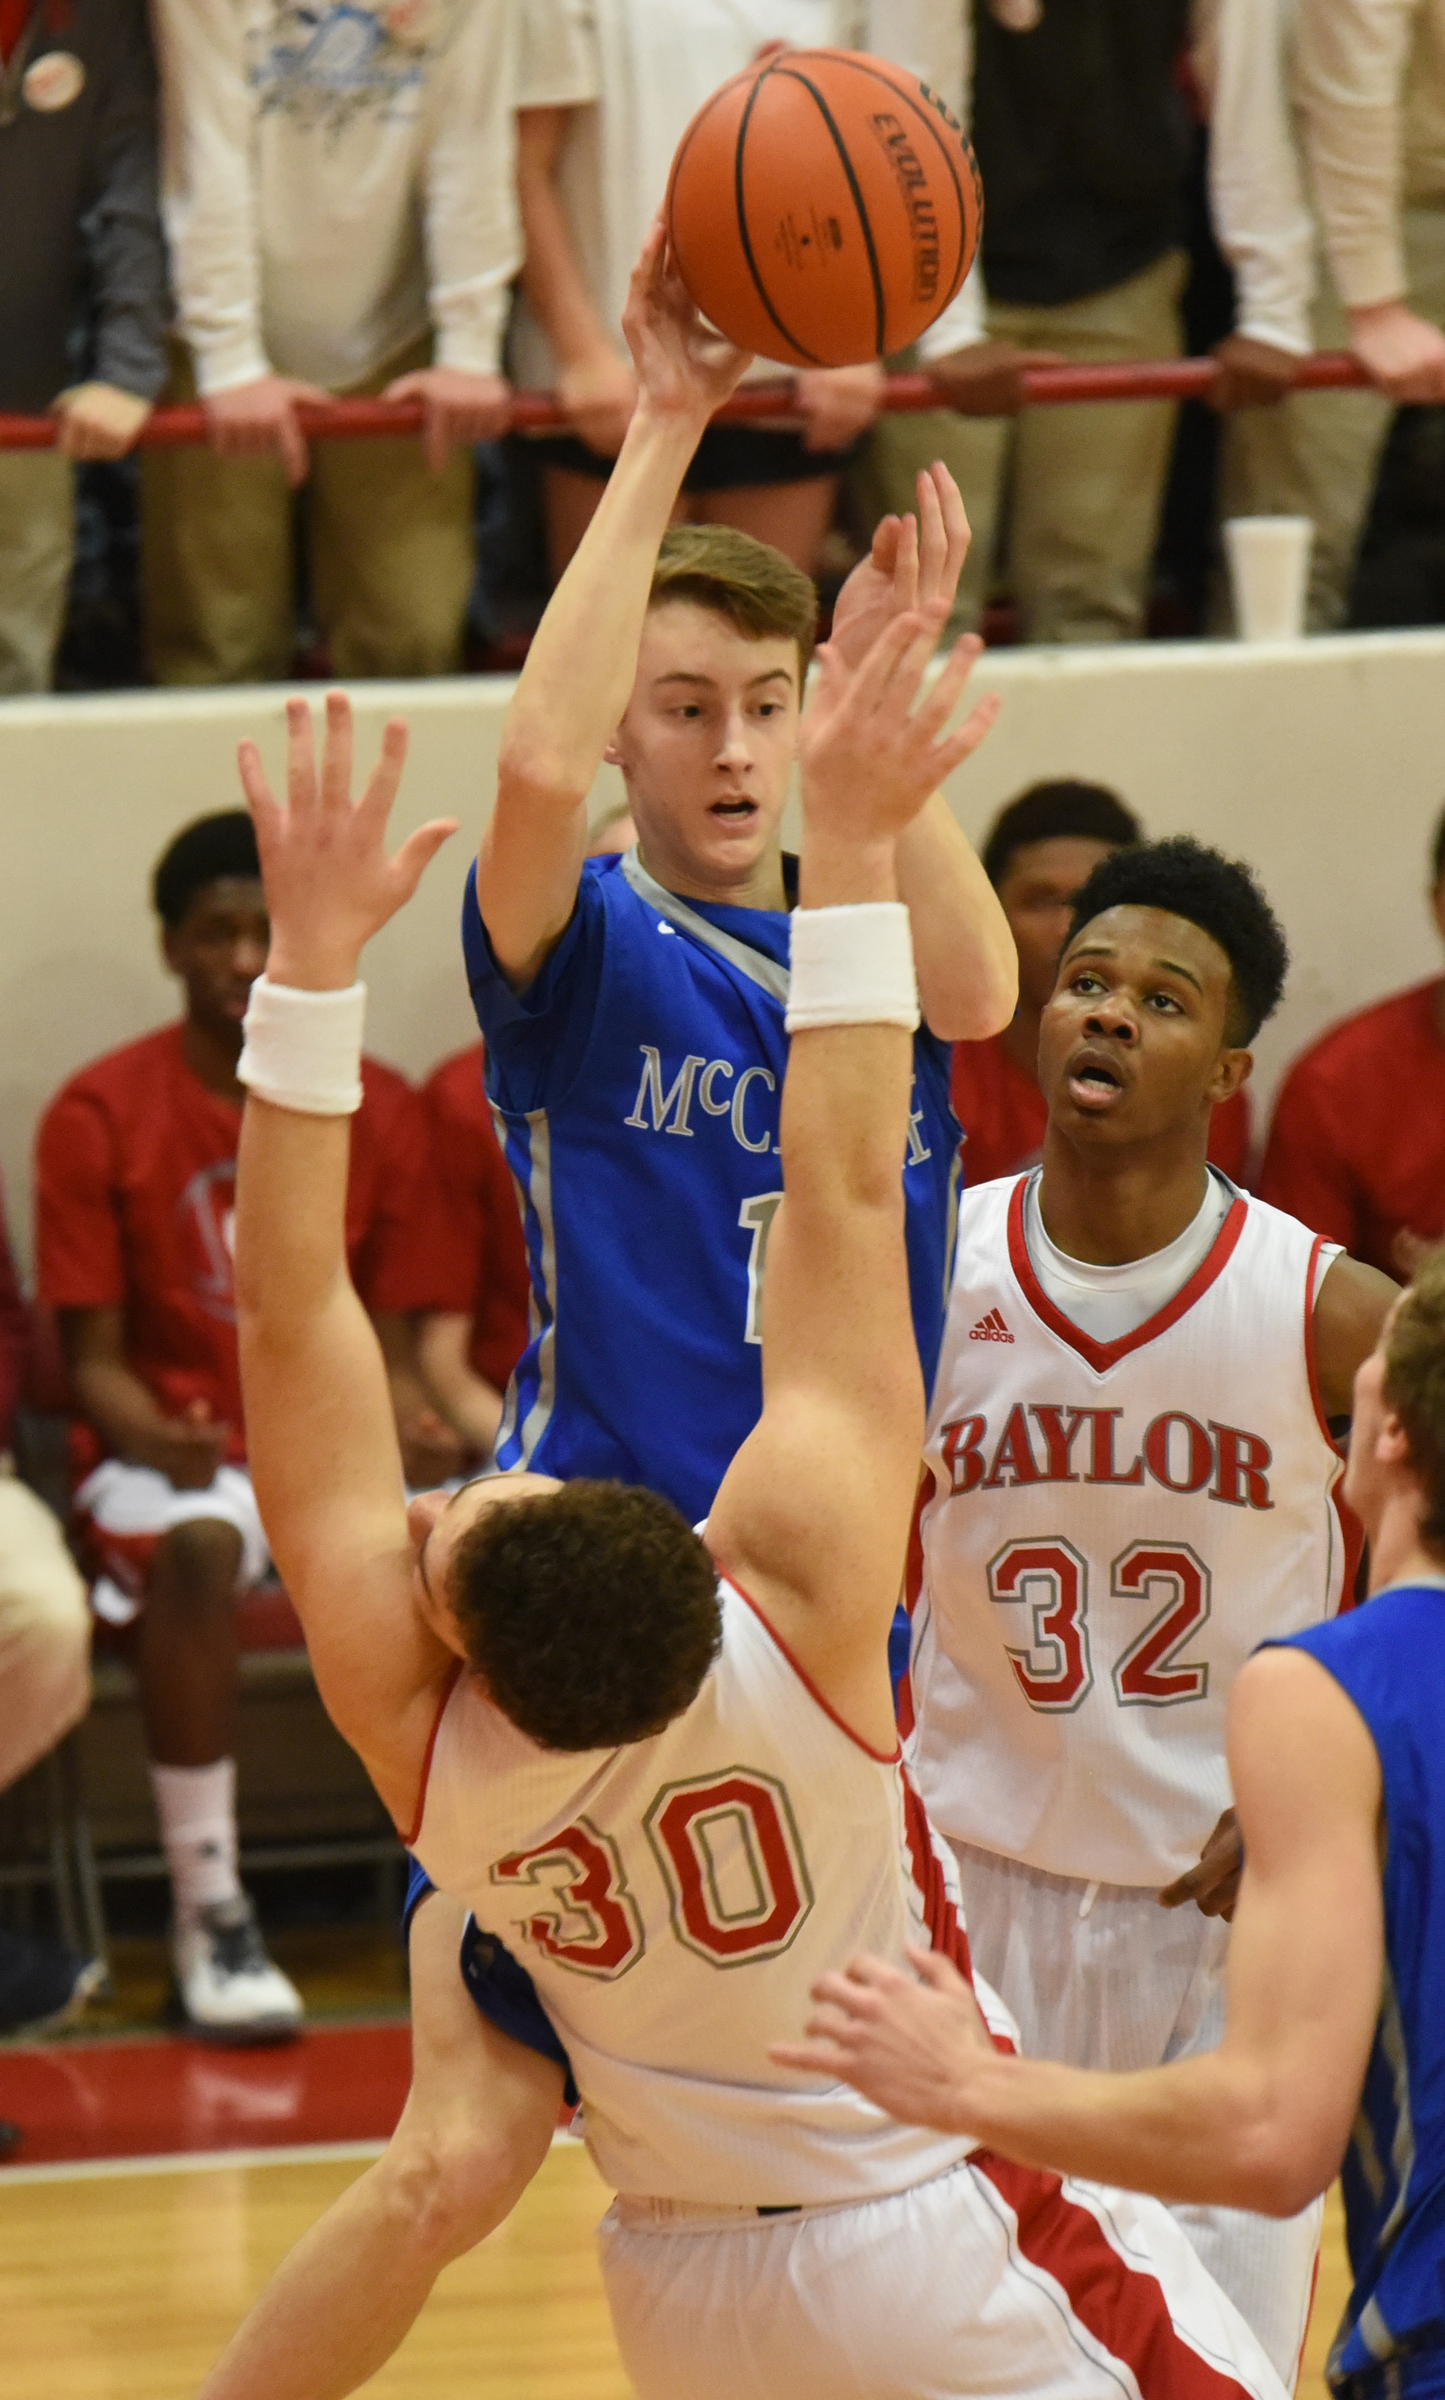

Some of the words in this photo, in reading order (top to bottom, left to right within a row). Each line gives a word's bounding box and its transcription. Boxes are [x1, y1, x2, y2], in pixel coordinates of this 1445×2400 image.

[869, 112, 940, 303] EVOLUTION
[968, 1327, 1015, 1344] adidas
[940, 1402, 1275, 1511] BAYLOR
[985, 1535, 1212, 1714] 32
[489, 1764, 815, 1982] 30
